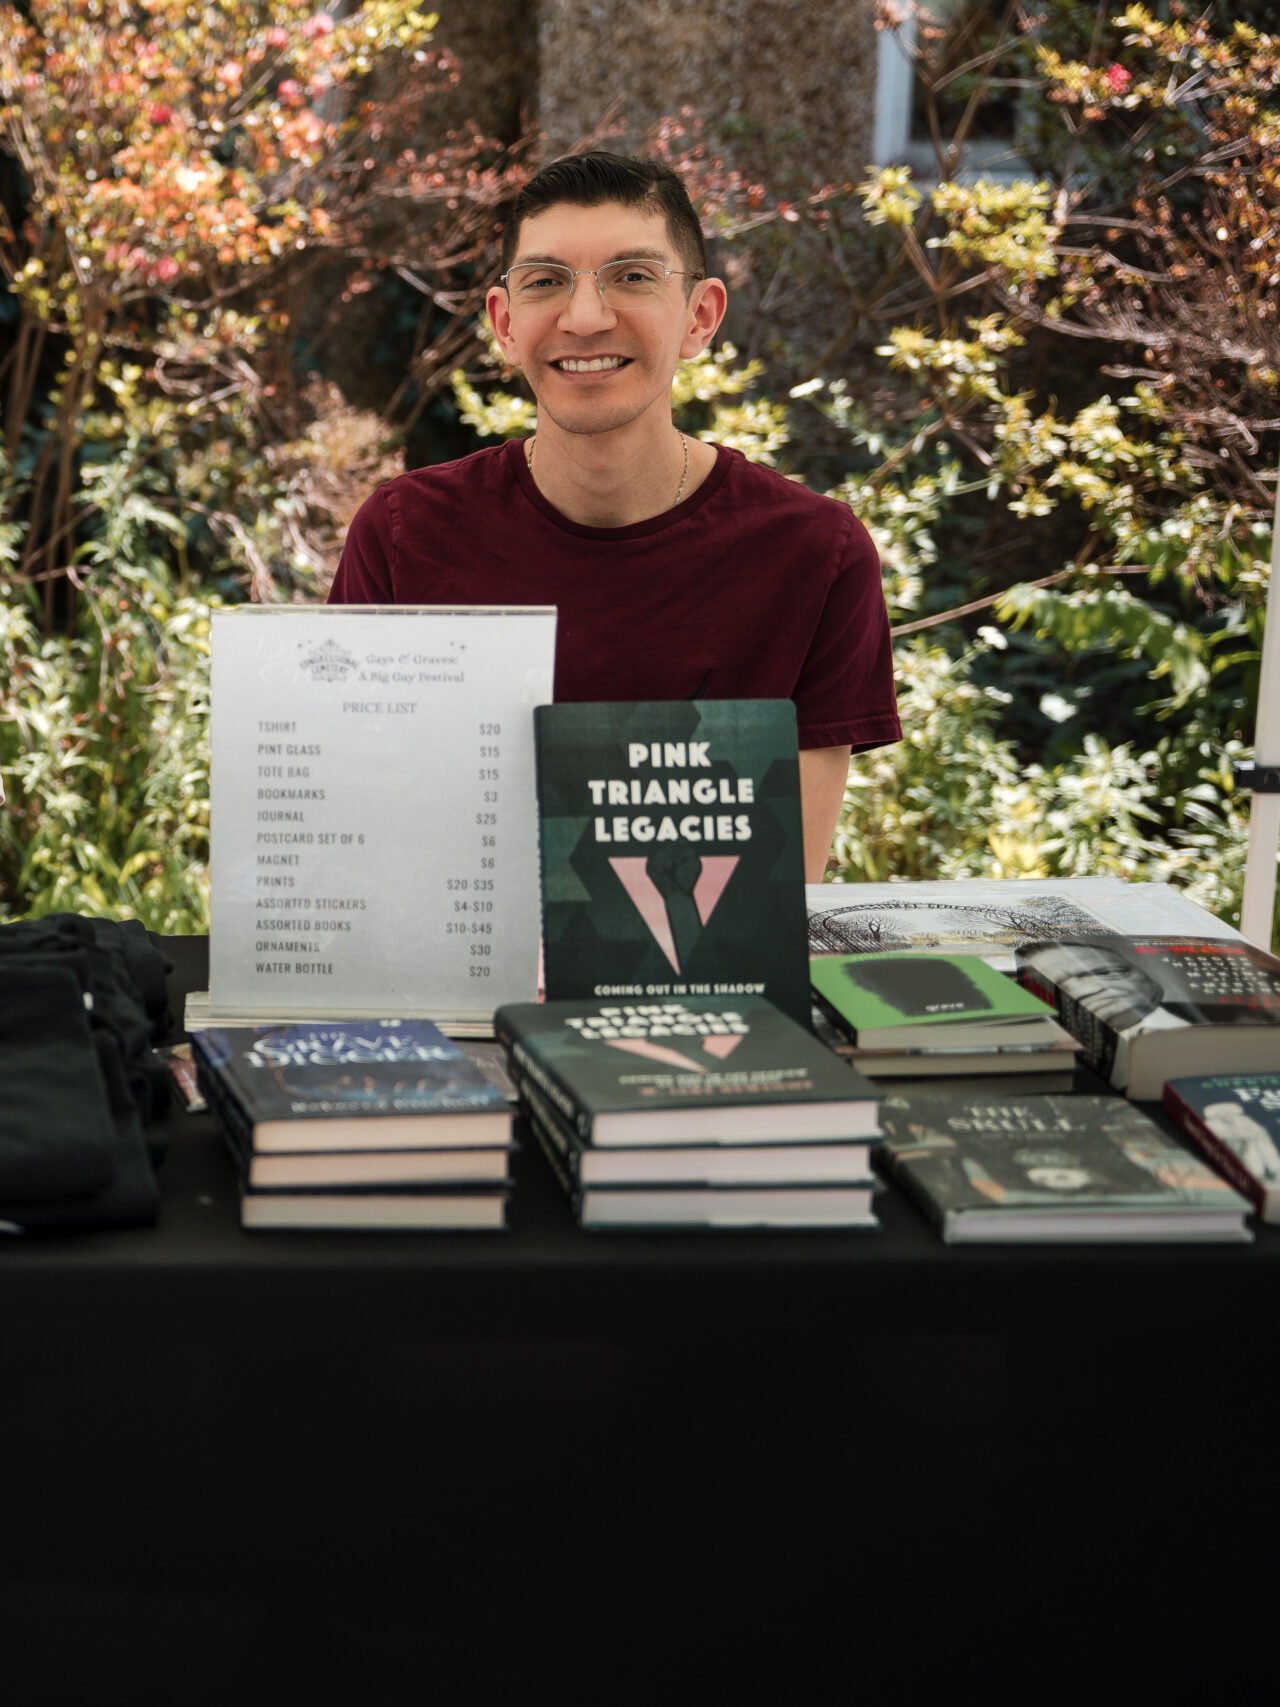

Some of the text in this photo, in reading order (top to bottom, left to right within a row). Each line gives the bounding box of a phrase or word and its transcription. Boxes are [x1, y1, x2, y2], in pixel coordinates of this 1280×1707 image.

[365, 654, 395, 666] Gays
[399, 653, 410, 665] &
[358, 671, 465, 684] A Big Gay Festival
[342, 702, 418, 714] PRICE LIST
[258, 721, 297, 733] TSHIRT
[479, 723, 501, 736] $20
[258, 744, 321, 756] PINT GLASS
[479, 746, 500, 758] $15
[628, 742, 712, 768] PINK
[257, 766, 310, 778] TOTE BAG
[478, 769, 499, 780] $15
[257, 788, 325, 800] BOOKMARKS
[483, 791, 498, 802] $3
[587, 778, 755, 805] TRIANGLE
[257, 811, 304, 822] JOURNAL
[475, 813, 497, 825] $25
[594, 814, 752, 842] LEGACIES
[257, 832, 365, 845] POSTCARD SET OF 6
[481, 836, 496, 847] $6
[257, 854, 300, 866] MAGNET
[480, 858, 495, 869] $6
[256, 876, 295, 888] PRINTS
[446, 879, 494, 890] $20-$35
[256, 898, 366, 910] ASSORTED STICKERS
[453, 901, 493, 912] $4-$10
[256, 919, 351, 932] ASSORTED BOOKS
[446, 923, 493, 934] $10-$45
[255, 941, 320, 952] ORNAMENTS
[470, 944, 491, 956] $30
[255, 962, 334, 975] WATER BOTTLE
[469, 966, 490, 977] $20
[594, 983, 766, 996] COMING OUT IN THE SHADOW
